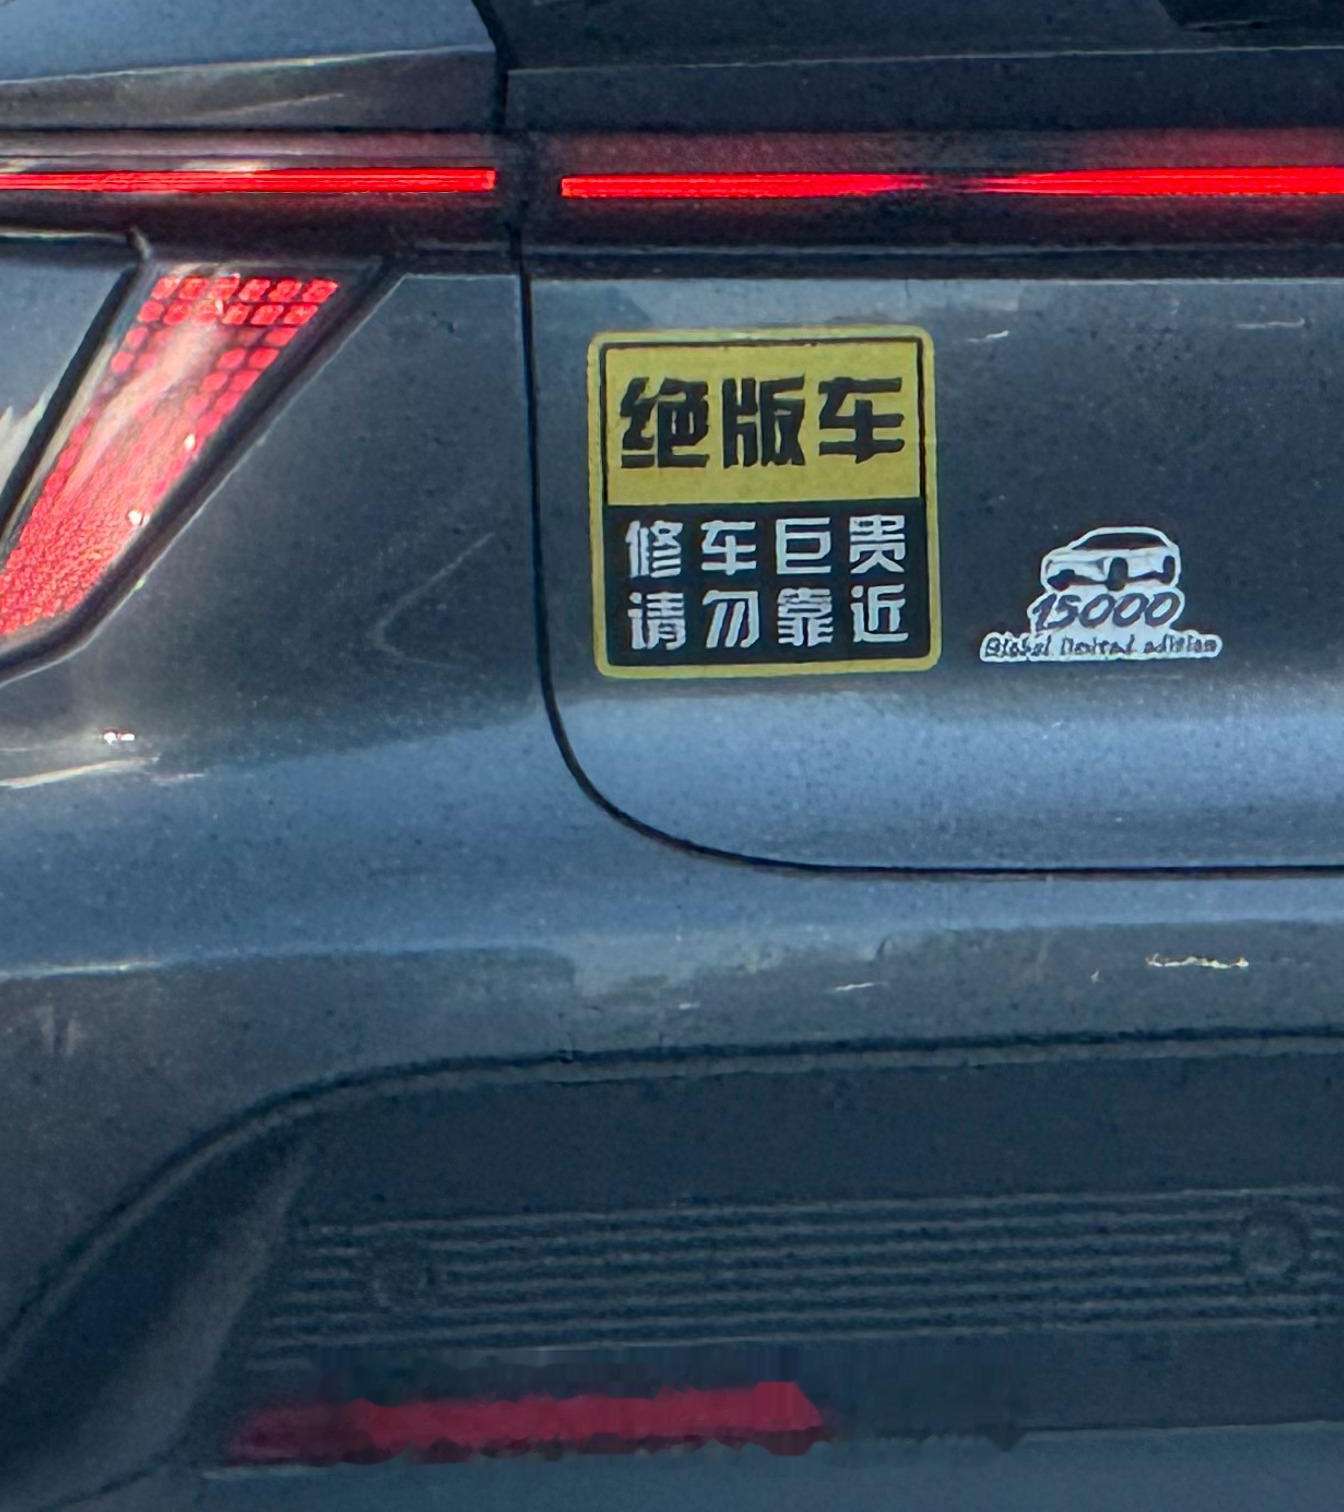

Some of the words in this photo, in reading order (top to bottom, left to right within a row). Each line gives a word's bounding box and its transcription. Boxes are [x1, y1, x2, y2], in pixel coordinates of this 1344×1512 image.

[619, 374, 906, 469] 绝版车
[625, 513, 906, 579] 修车巨贵
[627, 583, 909, 651] 请勿靠近
[1031, 590, 1182, 633] 15000
